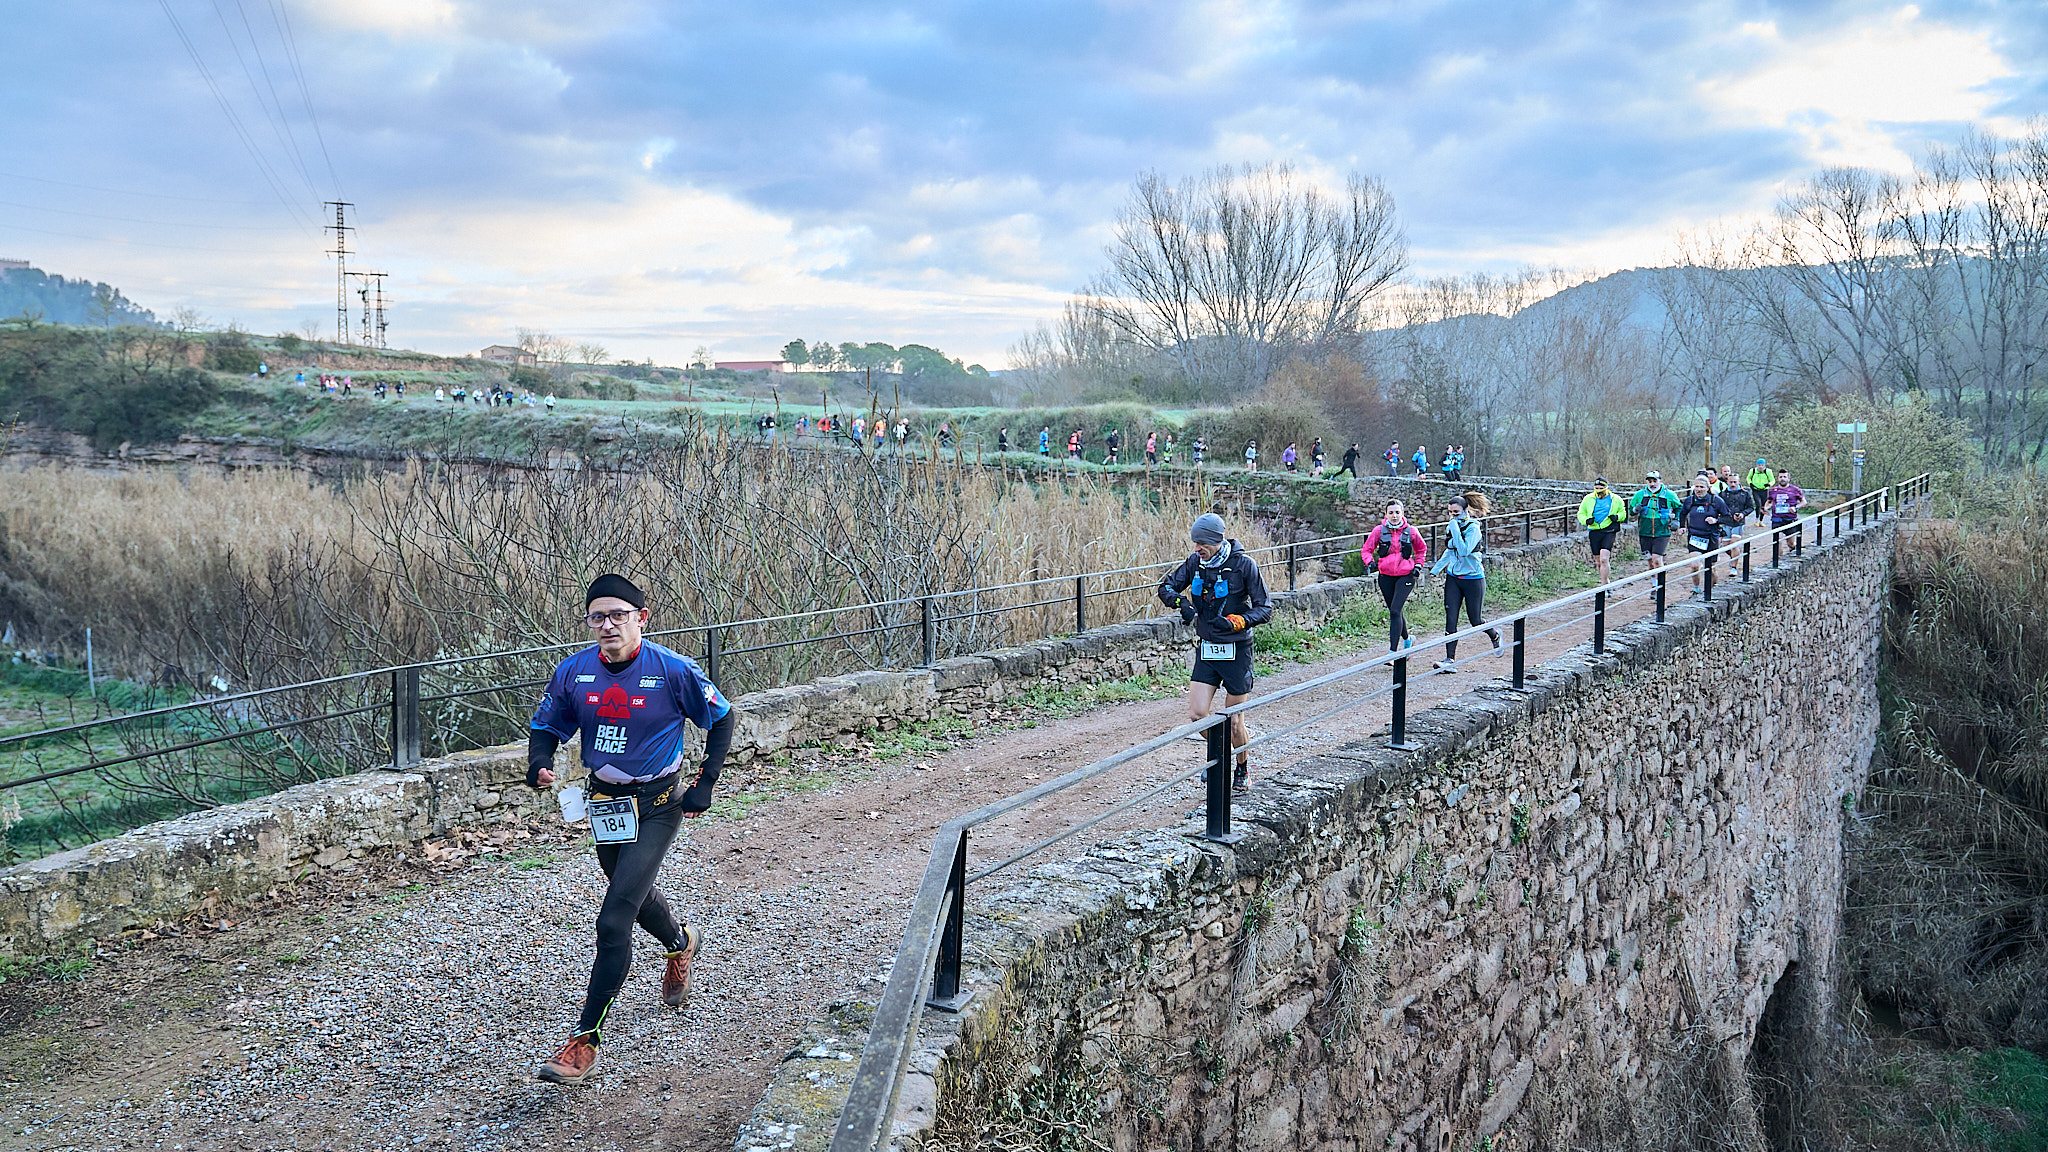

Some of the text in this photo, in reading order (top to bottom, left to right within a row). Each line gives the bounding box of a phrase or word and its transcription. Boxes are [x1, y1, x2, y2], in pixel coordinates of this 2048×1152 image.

[1210, 645, 1226, 654] 134
[632, 698, 646, 706] 15K
[597, 724, 628, 741] BELL
[594, 737, 627, 754] RACE
[601, 816, 626, 832] 184
